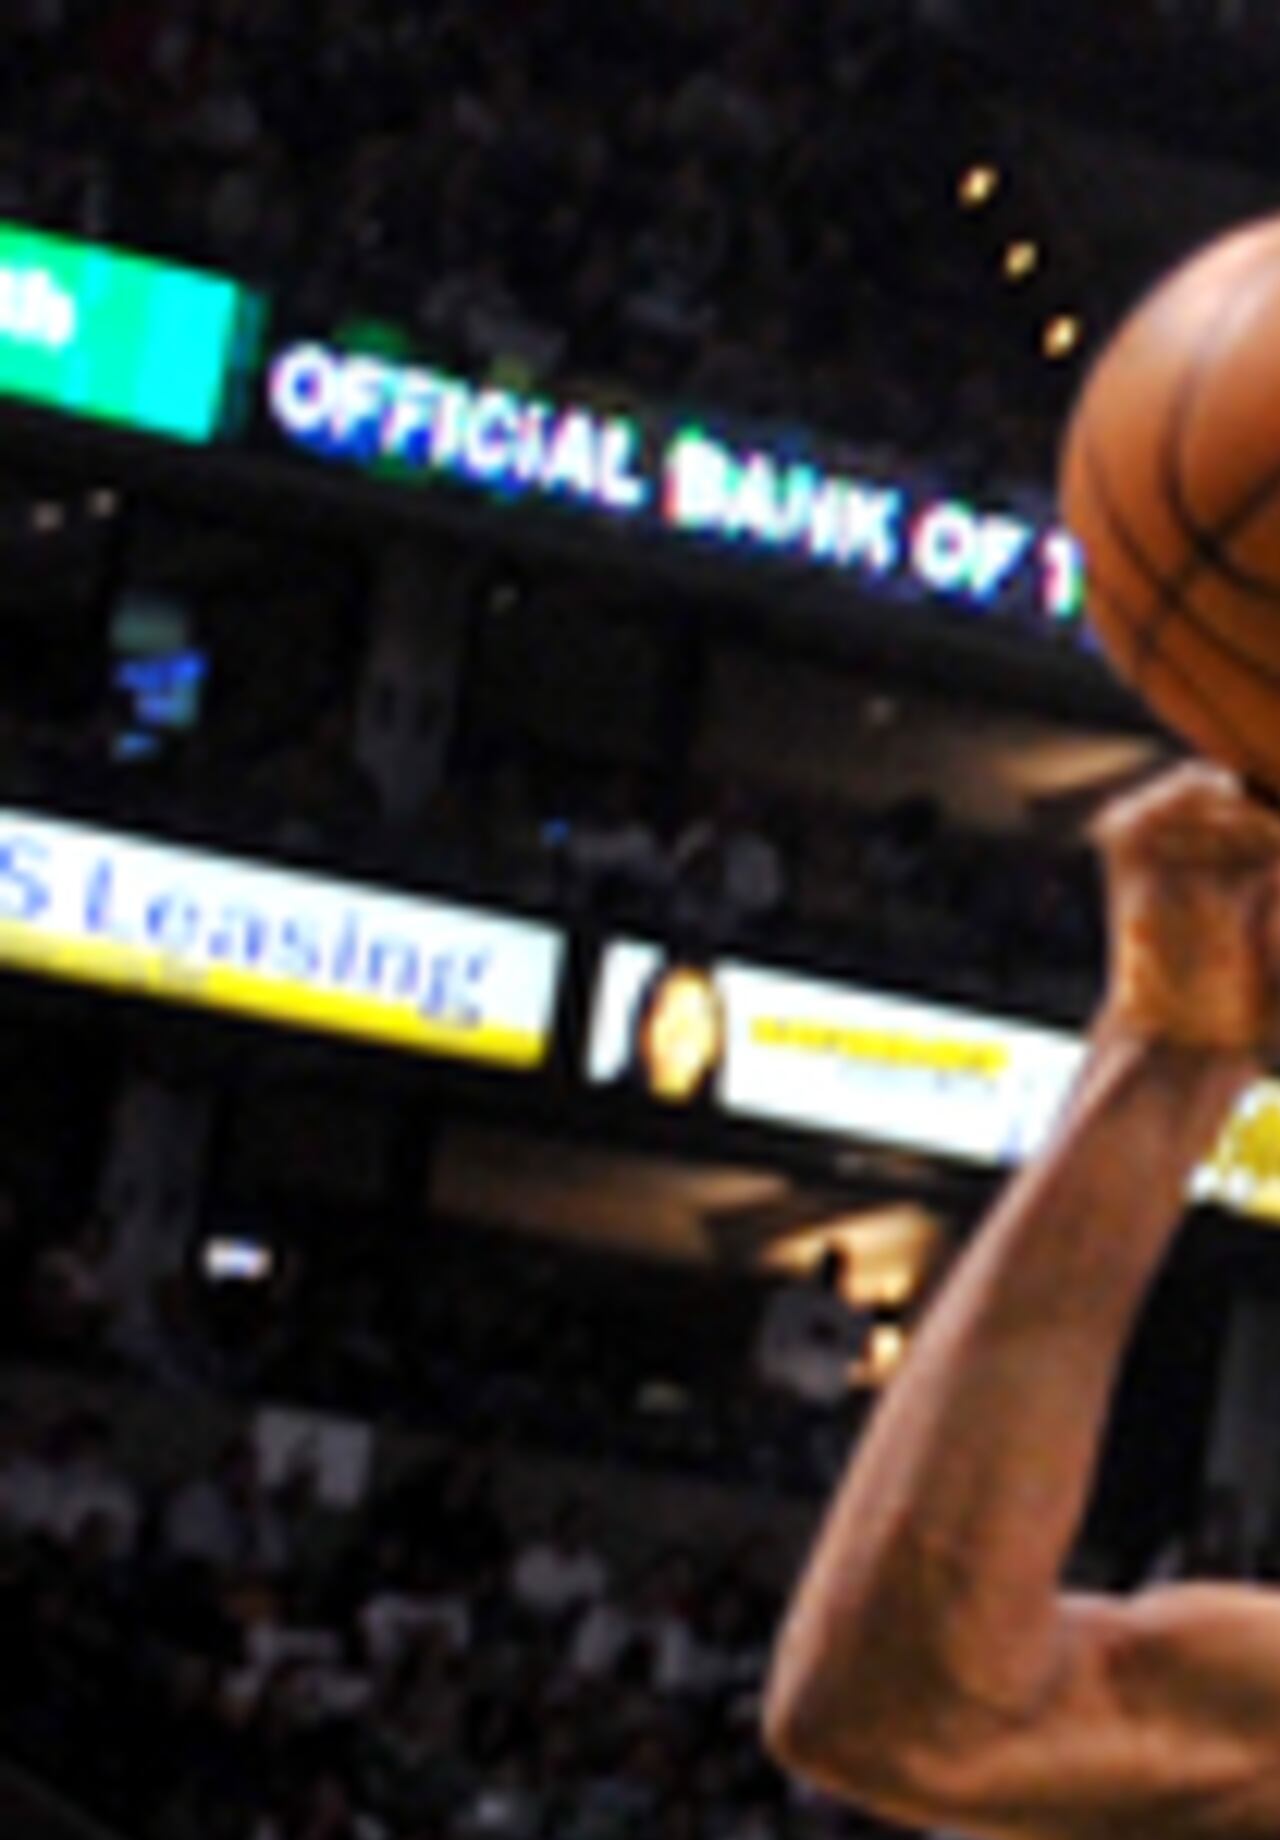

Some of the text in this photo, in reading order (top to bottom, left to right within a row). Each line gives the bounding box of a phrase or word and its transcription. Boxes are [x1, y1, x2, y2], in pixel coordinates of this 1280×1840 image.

[266, 342, 645, 508] OFFICIAL
[664, 430, 904, 572] BANK
[85, 855, 492, 1032] Leasing
